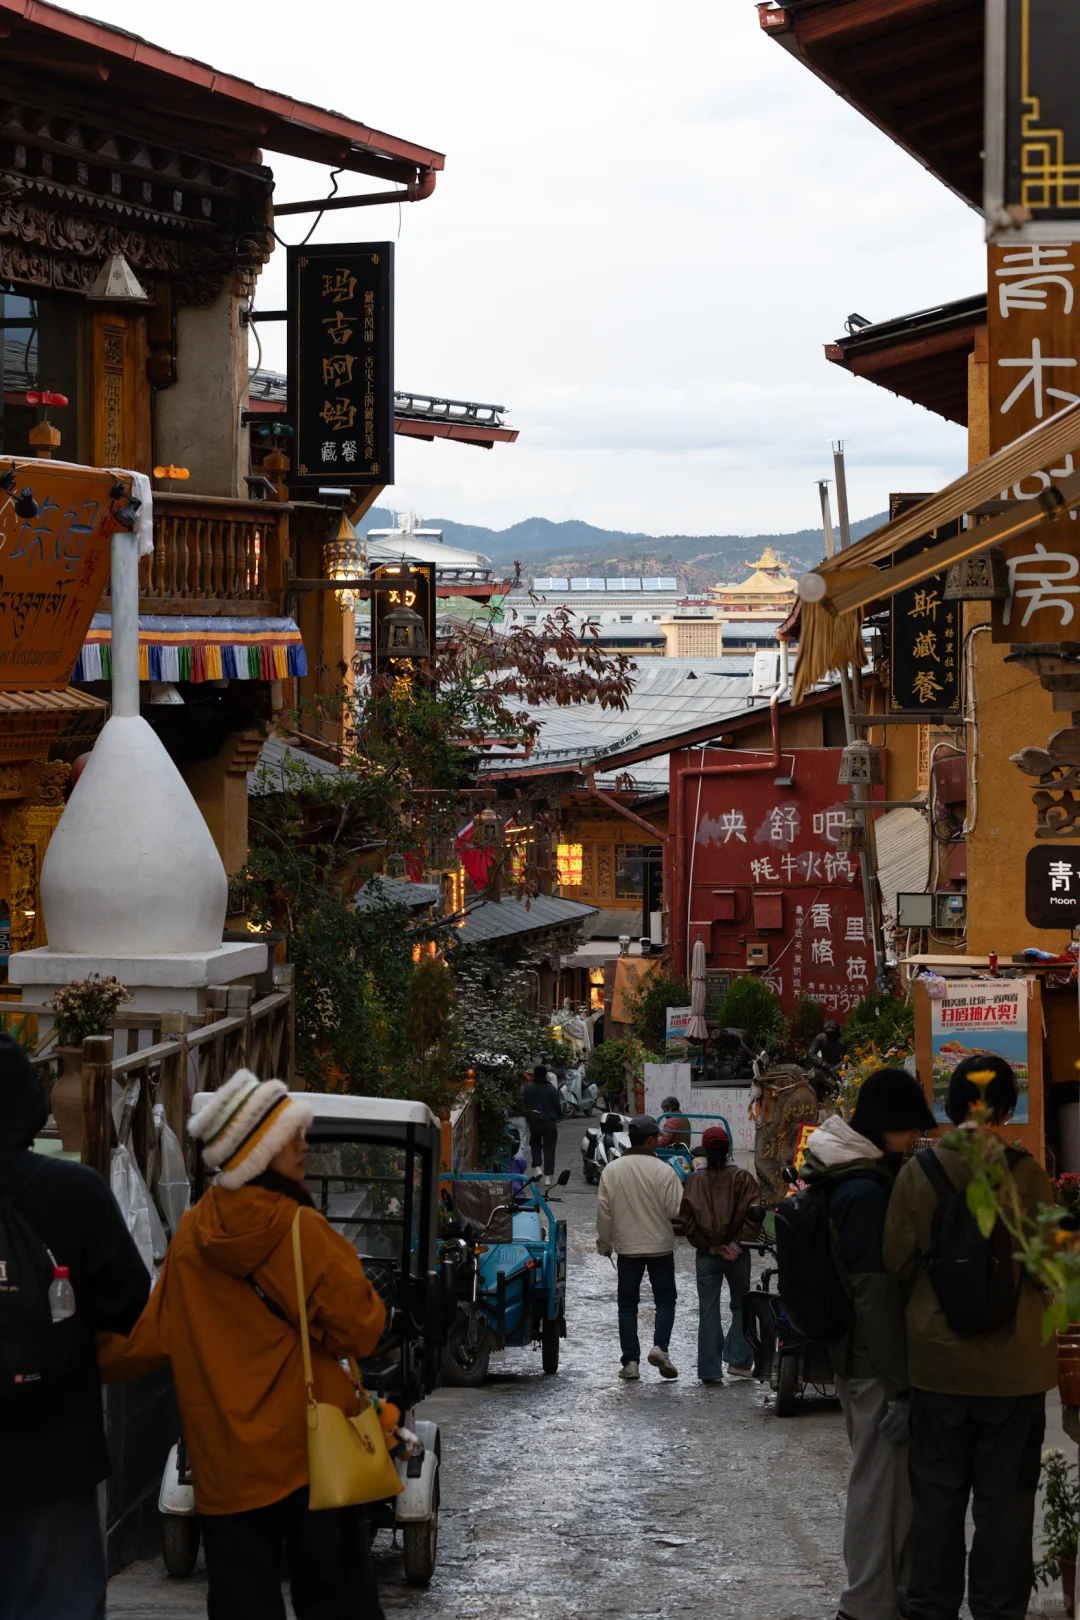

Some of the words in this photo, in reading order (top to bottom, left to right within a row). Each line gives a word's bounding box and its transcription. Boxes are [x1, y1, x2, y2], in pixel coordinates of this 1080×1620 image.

[319, 268, 358, 431] 玛吉阿妈
[320, 440, 358, 462] 藏餐
[907, 530, 945, 705] 斯藏餐
[10, 643, 63, 666] Restaurant
[944, 612, 955, 684] 香格里拉店
[750, 850, 852, 884] 牦牛火锅
[1048, 860, 1080, 891] 青
[1050, 897, 1077, 905] Moon
